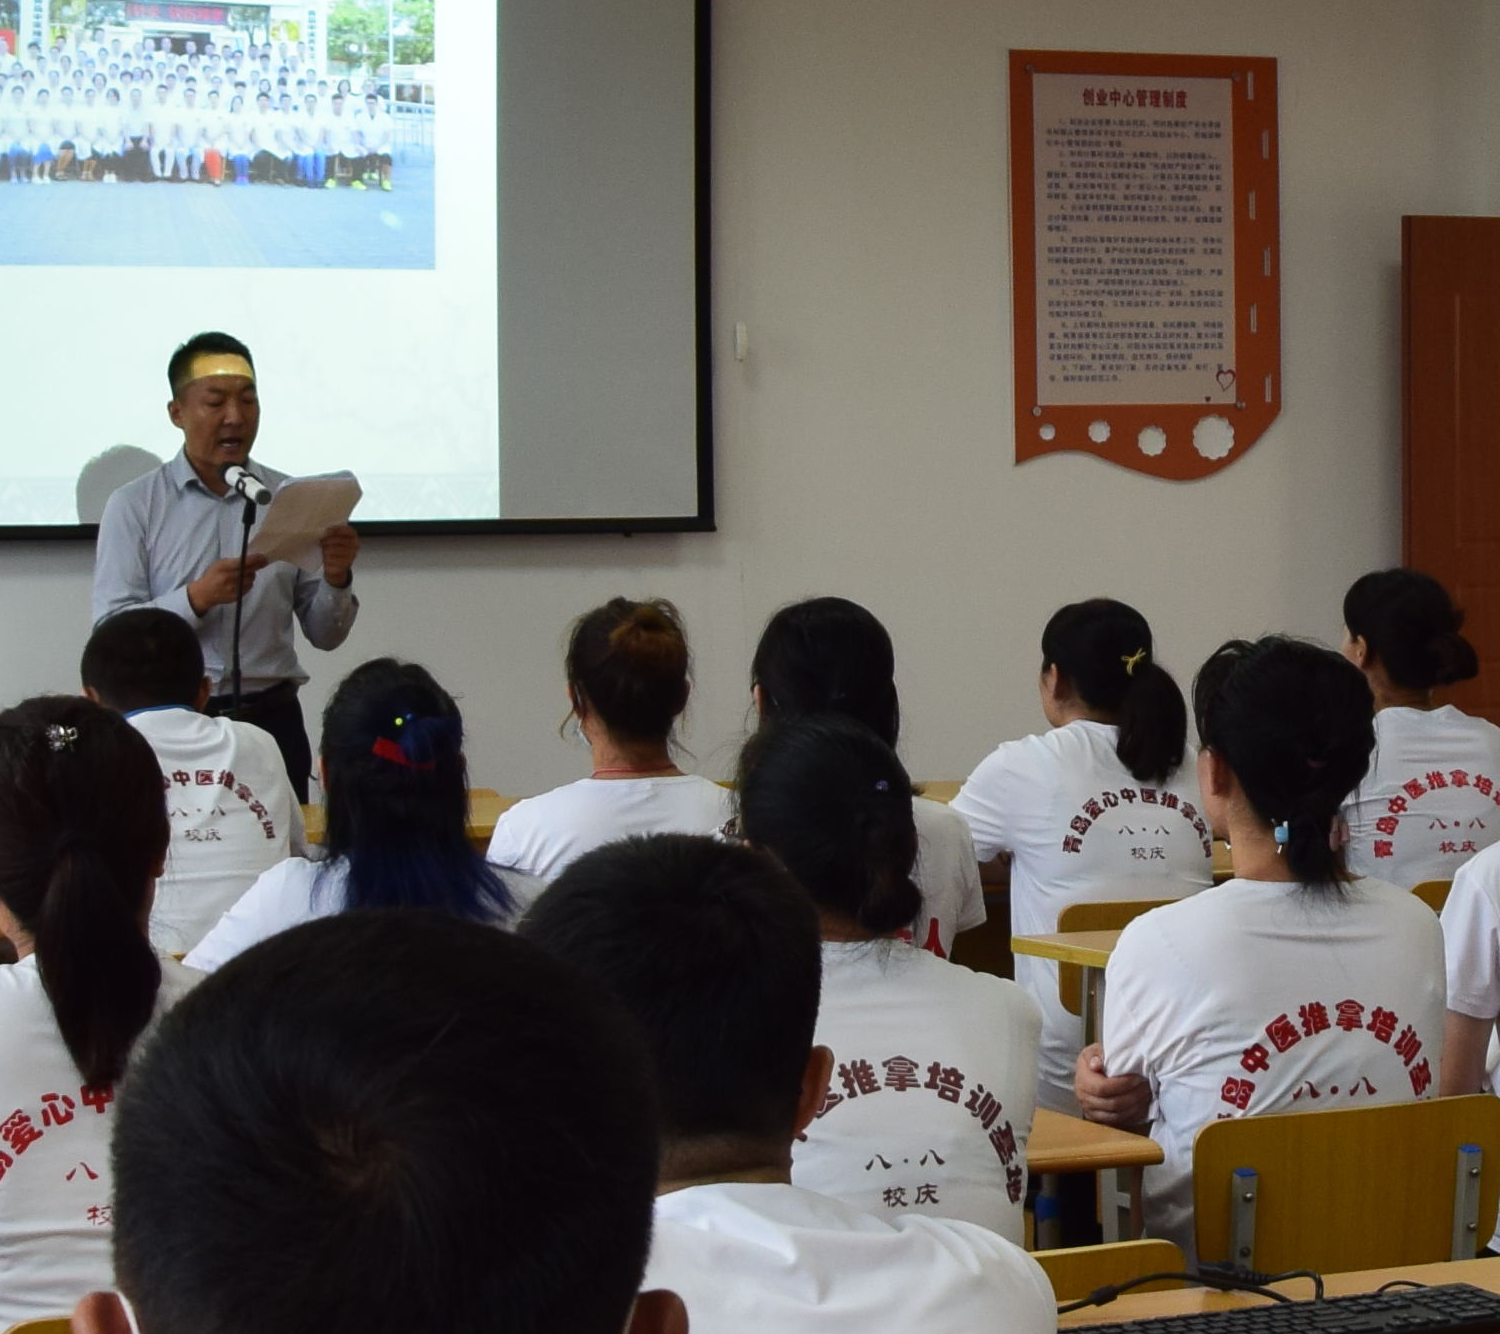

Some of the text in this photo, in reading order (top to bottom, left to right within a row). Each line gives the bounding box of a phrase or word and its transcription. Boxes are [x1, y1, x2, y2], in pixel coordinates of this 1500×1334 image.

[1082, 88, 1188, 109] 创业中心管理制度
[1131, 846, 1167, 860] 校庆
[1439, 840, 1477, 854] 校庆
[882, 1183, 940, 1208] 校庆
